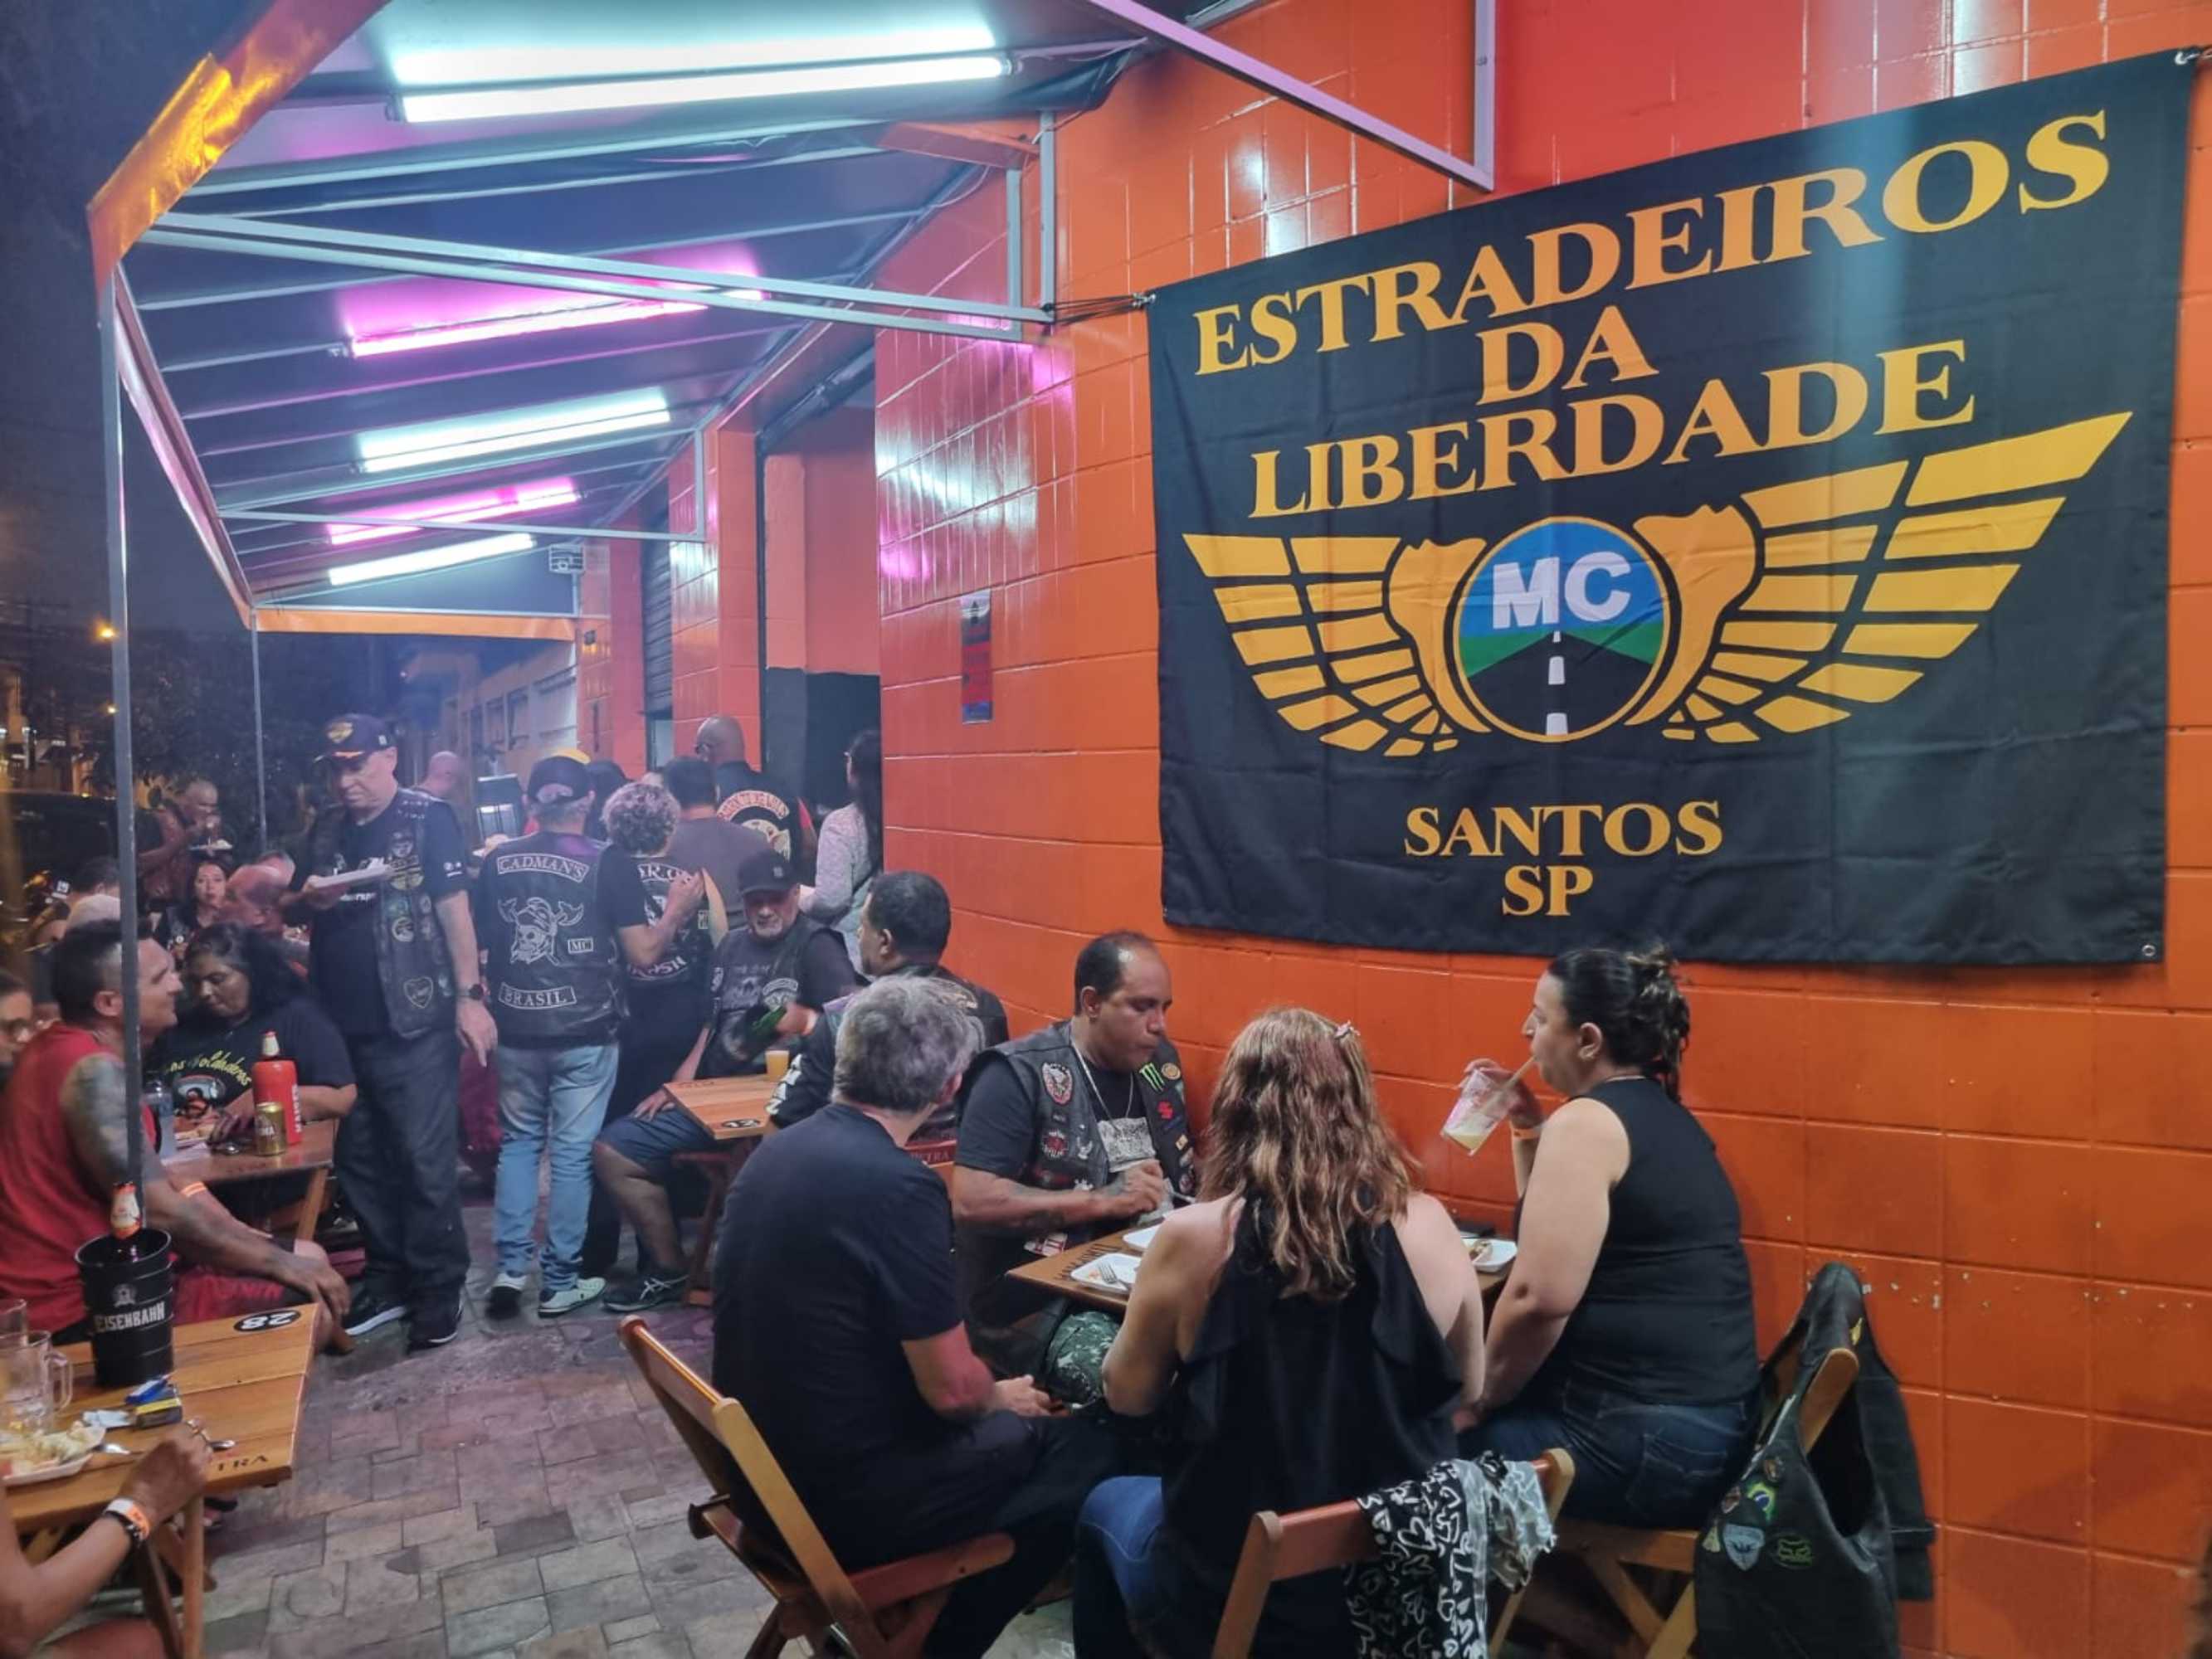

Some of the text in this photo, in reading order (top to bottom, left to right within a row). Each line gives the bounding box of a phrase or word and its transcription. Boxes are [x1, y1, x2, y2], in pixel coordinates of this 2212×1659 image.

[1195, 111, 2110, 376] ESTRADEIROS
[1475, 305, 1658, 405] DA
[1250, 339, 1976, 518] LIBERDADE
[1491, 551, 1631, 630] MC
[1405, 800, 1723, 858] SANTOS
[1502, 865, 1595, 917] SP
[502, 987, 569, 1007] BRASIL
[94, 1301, 166, 1332] EISENBAHN
